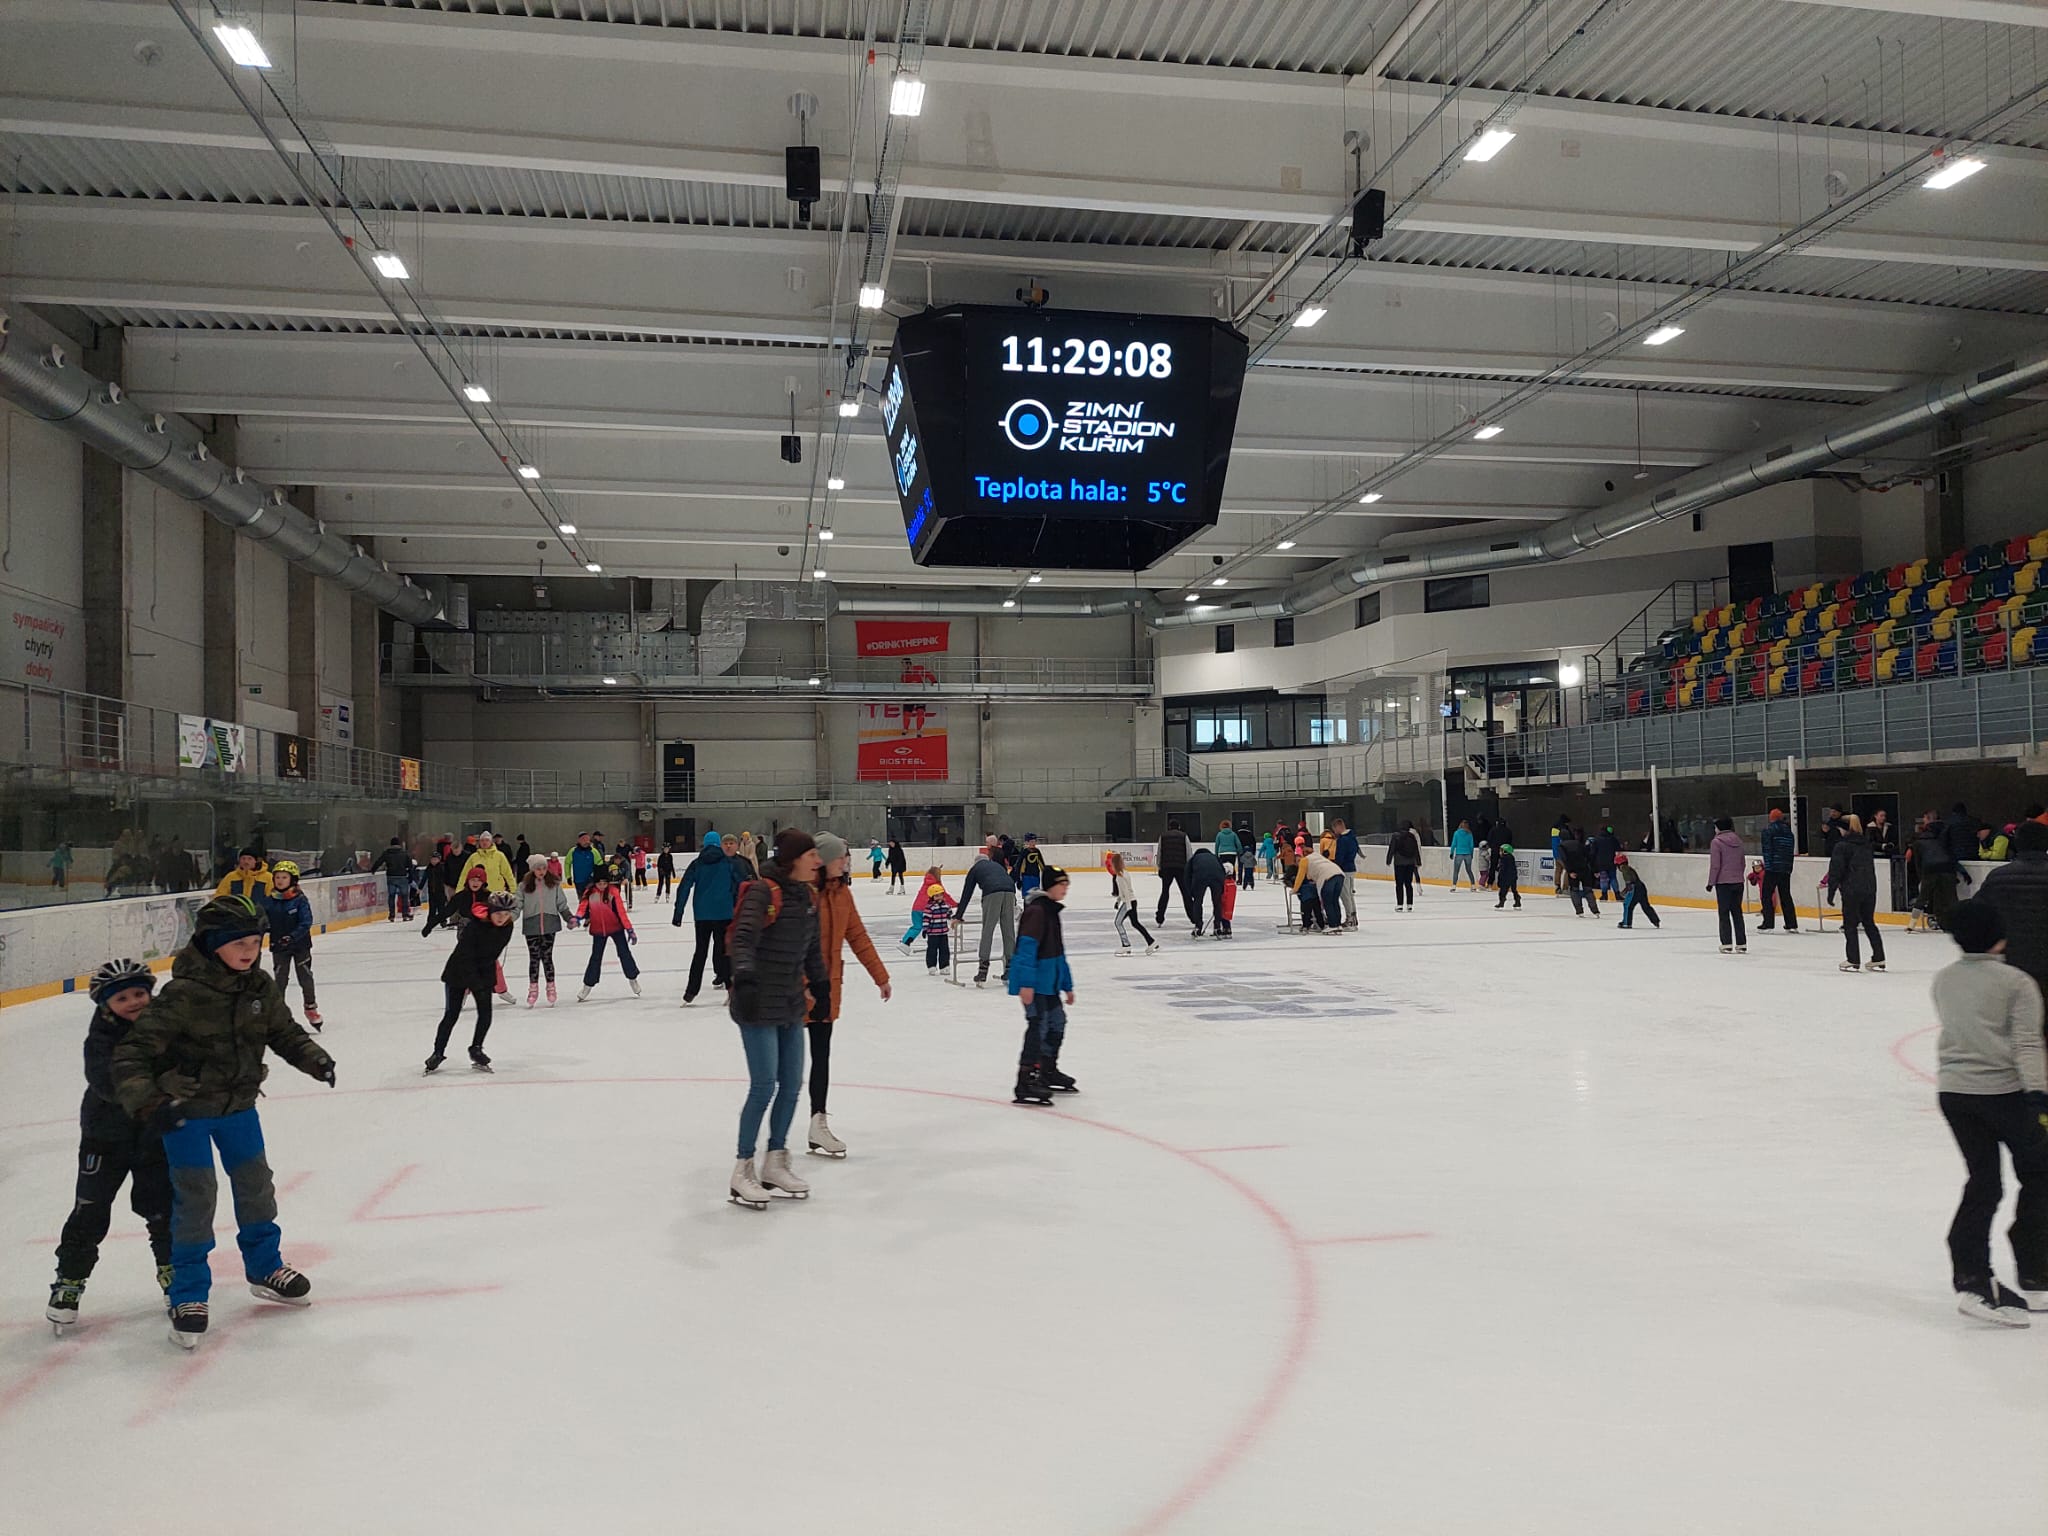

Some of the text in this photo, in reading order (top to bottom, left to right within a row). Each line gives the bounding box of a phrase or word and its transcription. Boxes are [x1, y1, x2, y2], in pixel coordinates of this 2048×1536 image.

[1001, 335, 1172, 379] 11:29:08
[1065, 401, 1144, 419] ZIMNÍ
[1062, 419, 1175, 437] STADION
[1059, 435, 1144, 453] KUŘIM
[975, 476, 1186, 503] Teplota hala: 5°C
[25, 637, 54, 660] chytrý
[866, 637, 939, 650] #DRINKTHEPINK
[879, 758, 926, 766] BIOSTEEL
